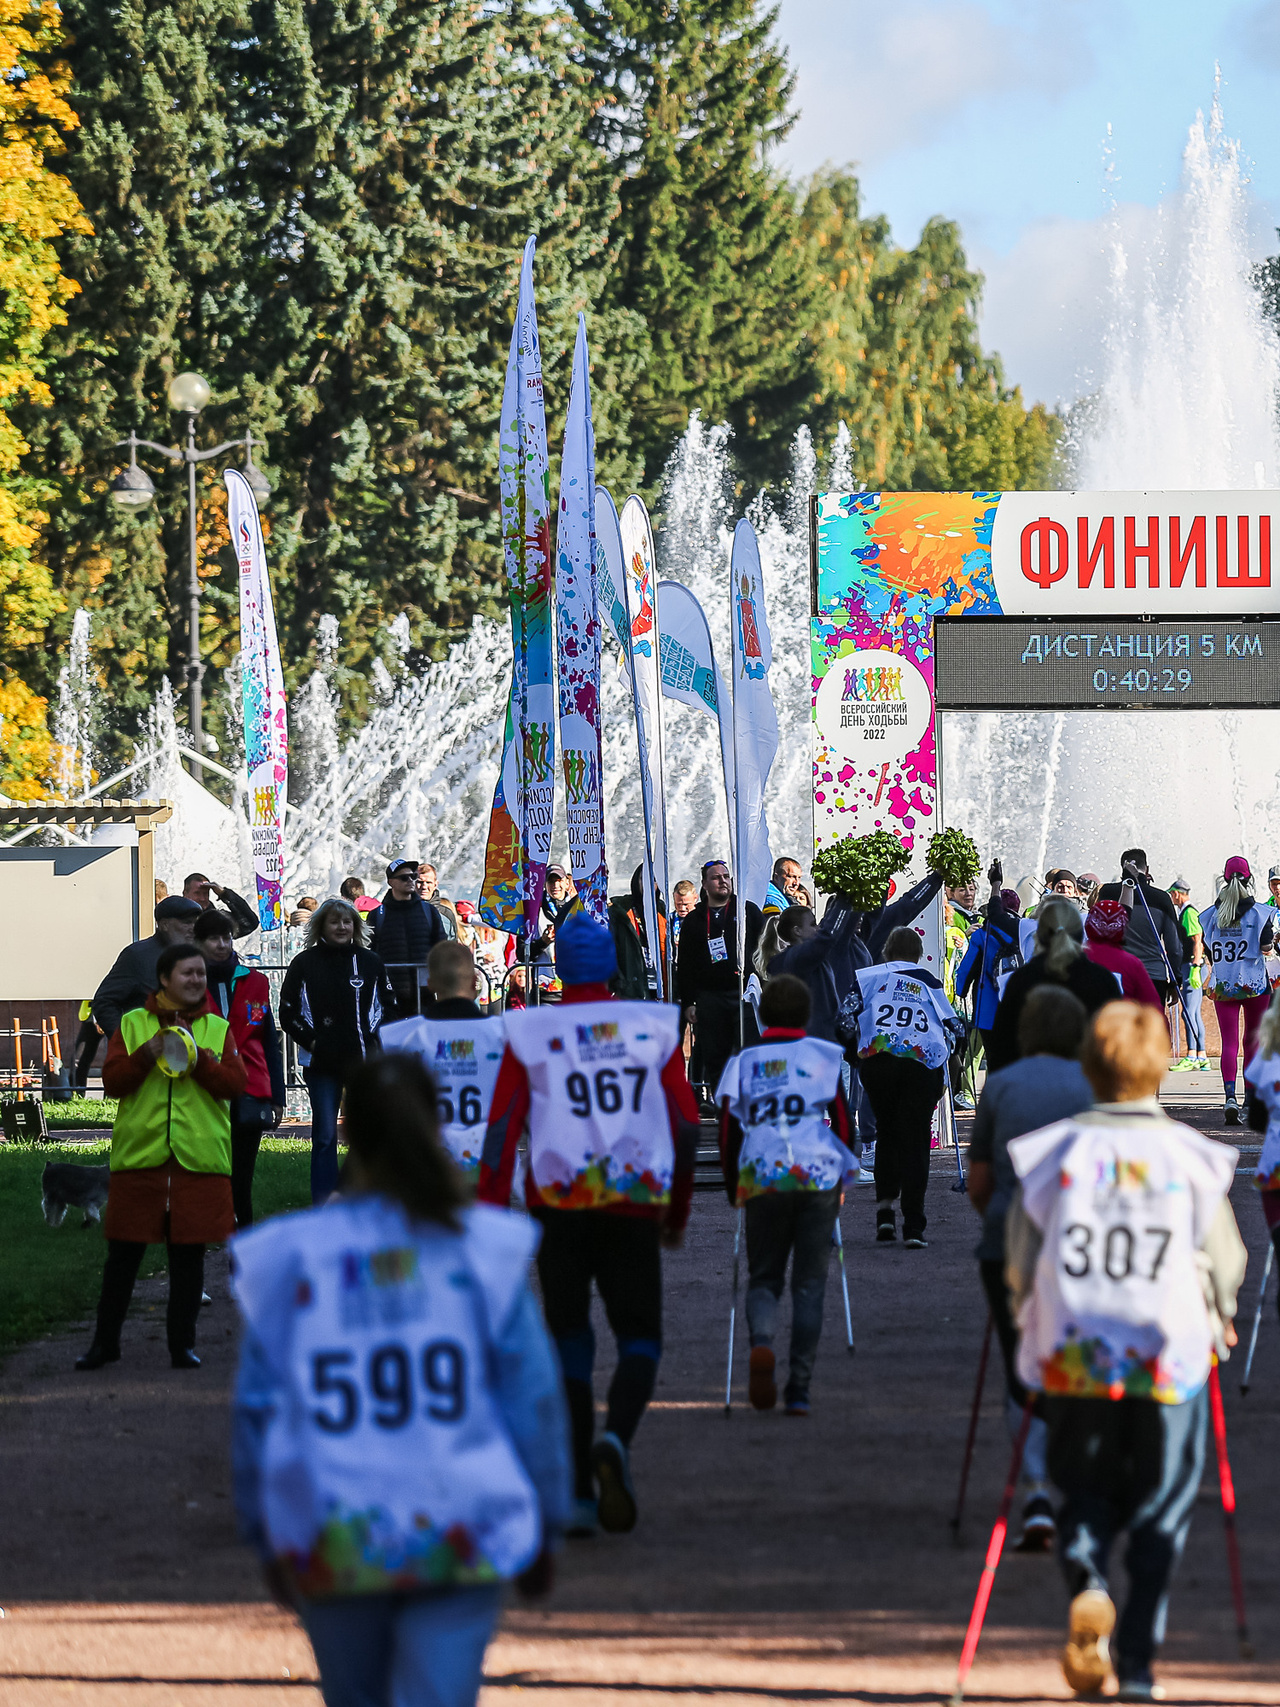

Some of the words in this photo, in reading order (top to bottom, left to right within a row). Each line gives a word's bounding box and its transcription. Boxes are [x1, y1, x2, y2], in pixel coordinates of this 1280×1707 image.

[1020, 516, 1272, 588] ФИНИШ
[1021, 634, 1190, 663] ДИСТАНЦИЯ
[1201, 635, 1214, 657] 5
[1226, 634, 1263, 657] КМ
[1093, 668, 1192, 691] 0:40:29
[840, 715, 866, 728] ДЕНЬ
[868, 714, 908, 727] ХОДЬБЫ
[841, 702, 907, 714] ВСЕРОССИЙСКИЙ
[863, 729, 886, 740] 2022
[1211, 940, 1248, 962] 632
[876, 1004, 929, 1033] 293
[434, 1085, 482, 1126] 56
[565, 1066, 650, 1119] 967
[1063, 1223, 1173, 1281] 307
[313, 1339, 466, 1435] 599
